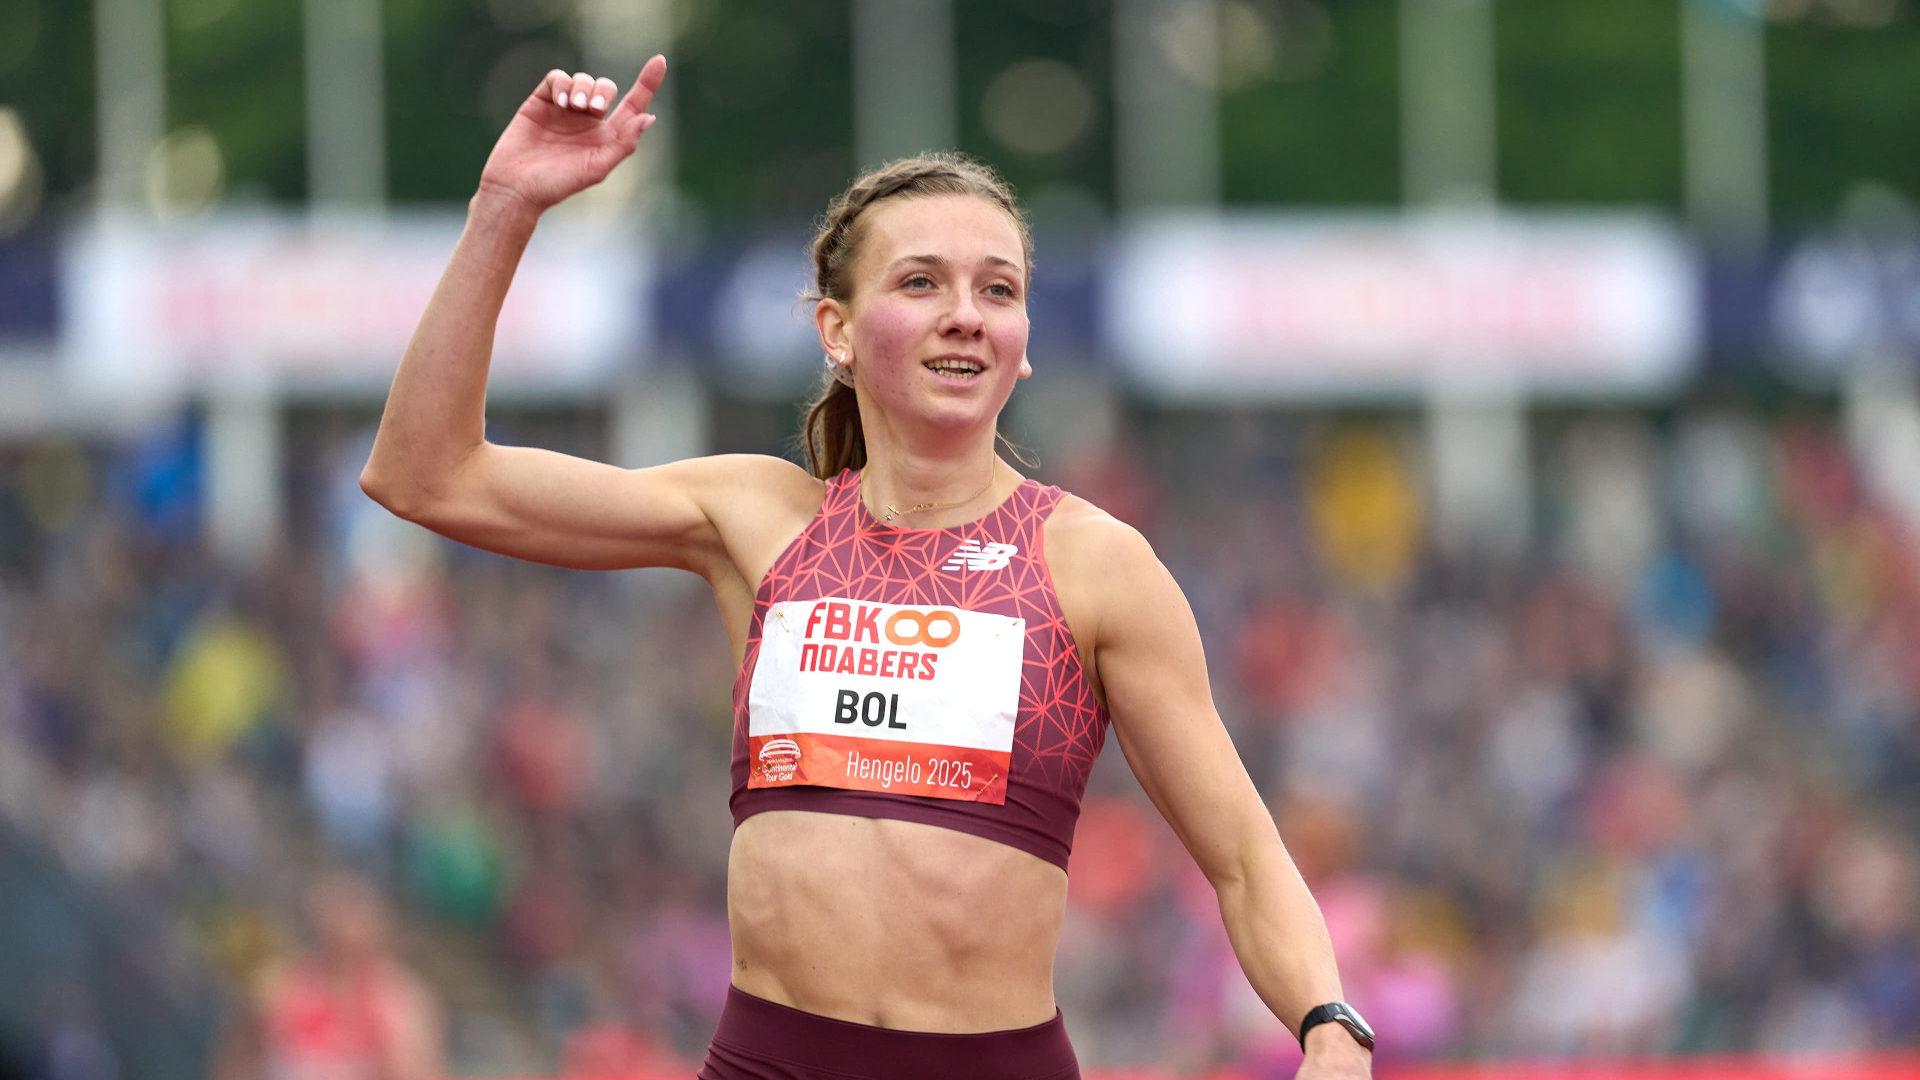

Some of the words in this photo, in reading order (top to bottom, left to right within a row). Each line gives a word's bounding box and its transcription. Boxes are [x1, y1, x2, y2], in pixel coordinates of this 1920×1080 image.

[805, 602, 882, 644] FBK
[834, 689, 907, 729] BOL
[765, 773, 778, 782] Tour
[778, 772, 793, 781] Gold
[846, 751, 921, 788] Hengelo
[927, 758, 973, 788] 2025
